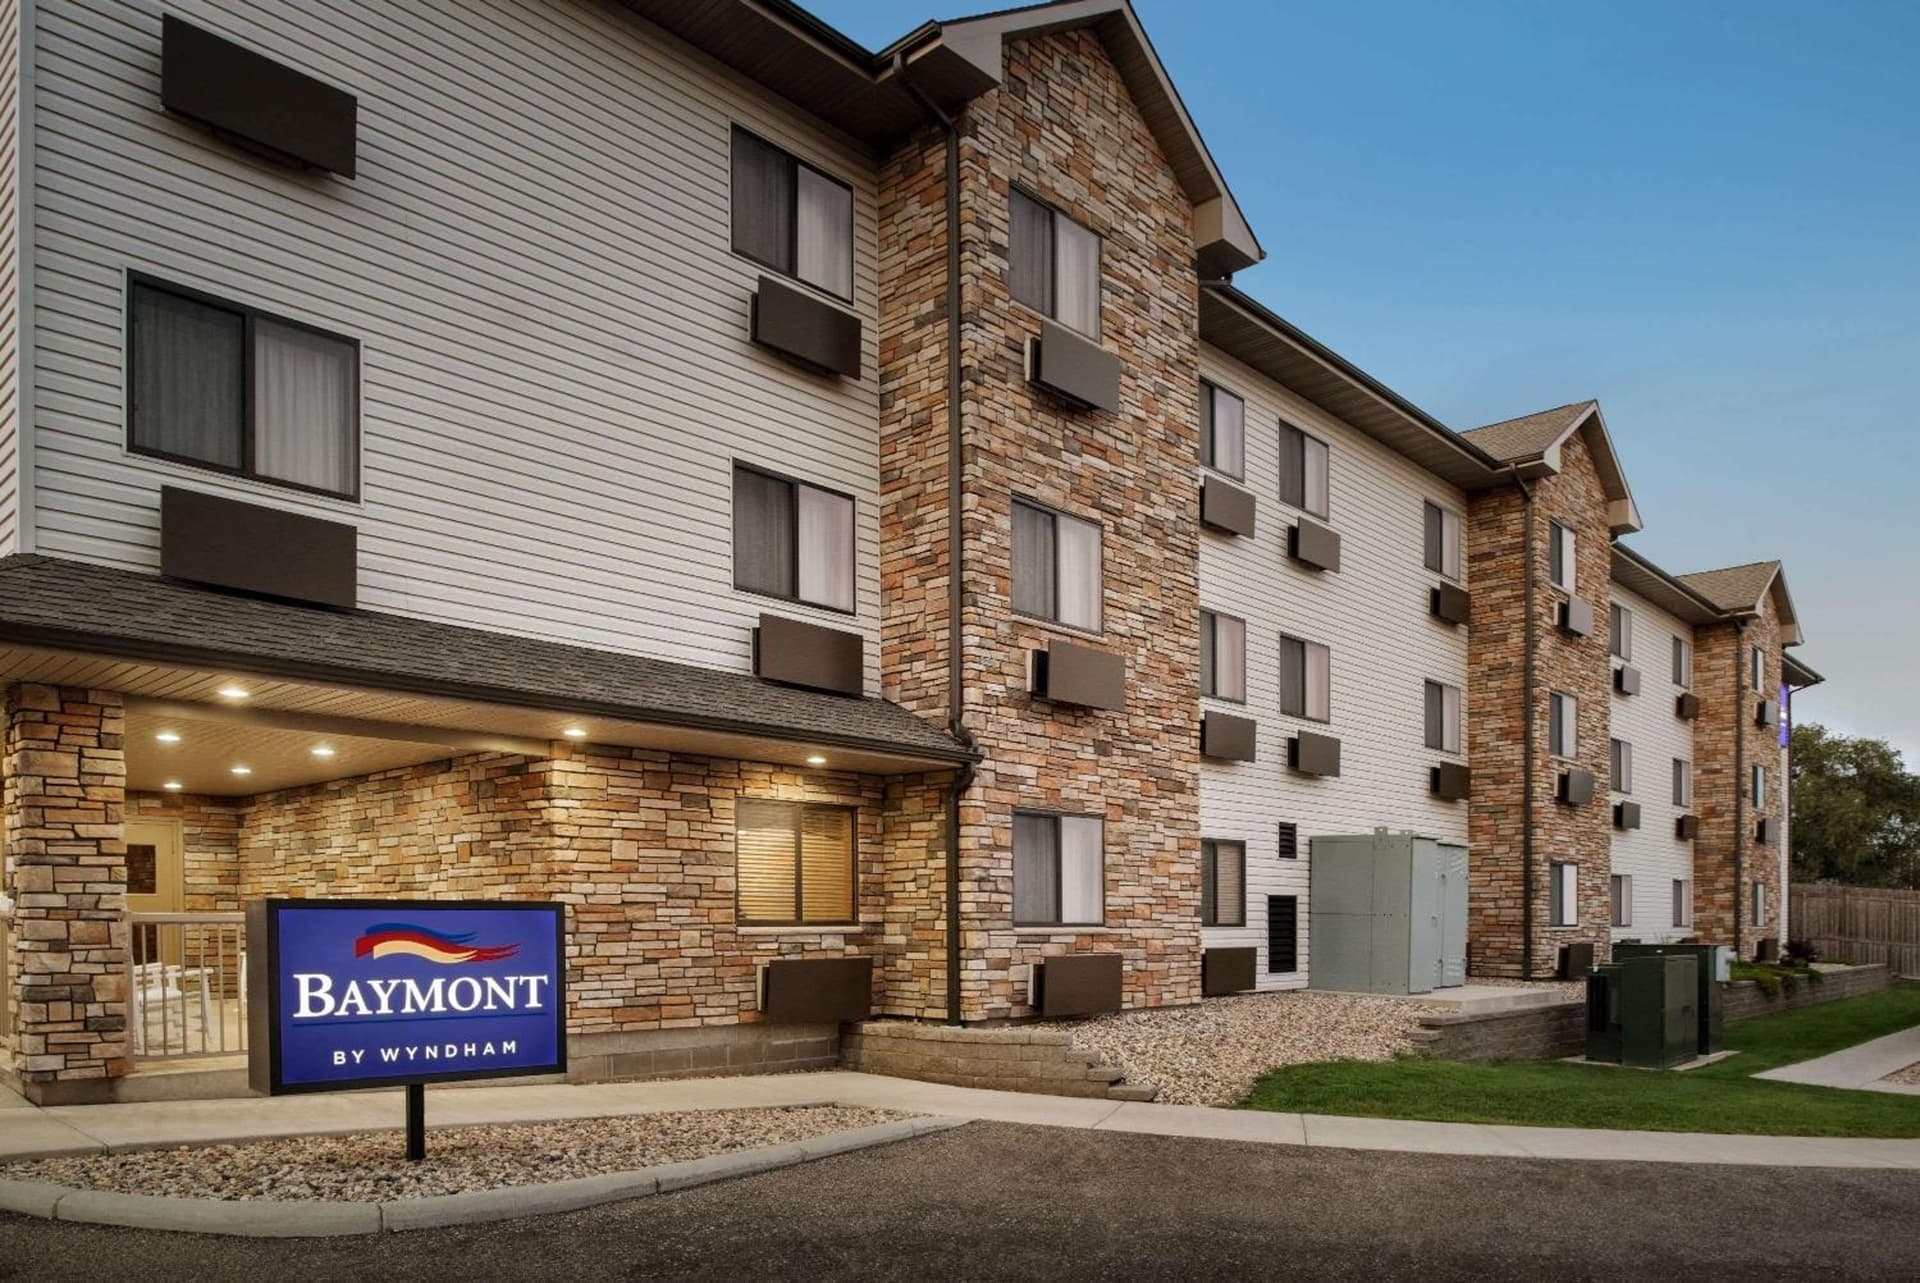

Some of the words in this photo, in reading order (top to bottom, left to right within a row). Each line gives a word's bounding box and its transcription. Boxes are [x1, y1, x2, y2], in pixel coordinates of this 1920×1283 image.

[293, 974, 548, 1018] BAYMONT
[333, 1050, 364, 1065] BY
[381, 1041, 516, 1062] WYNDHAM
